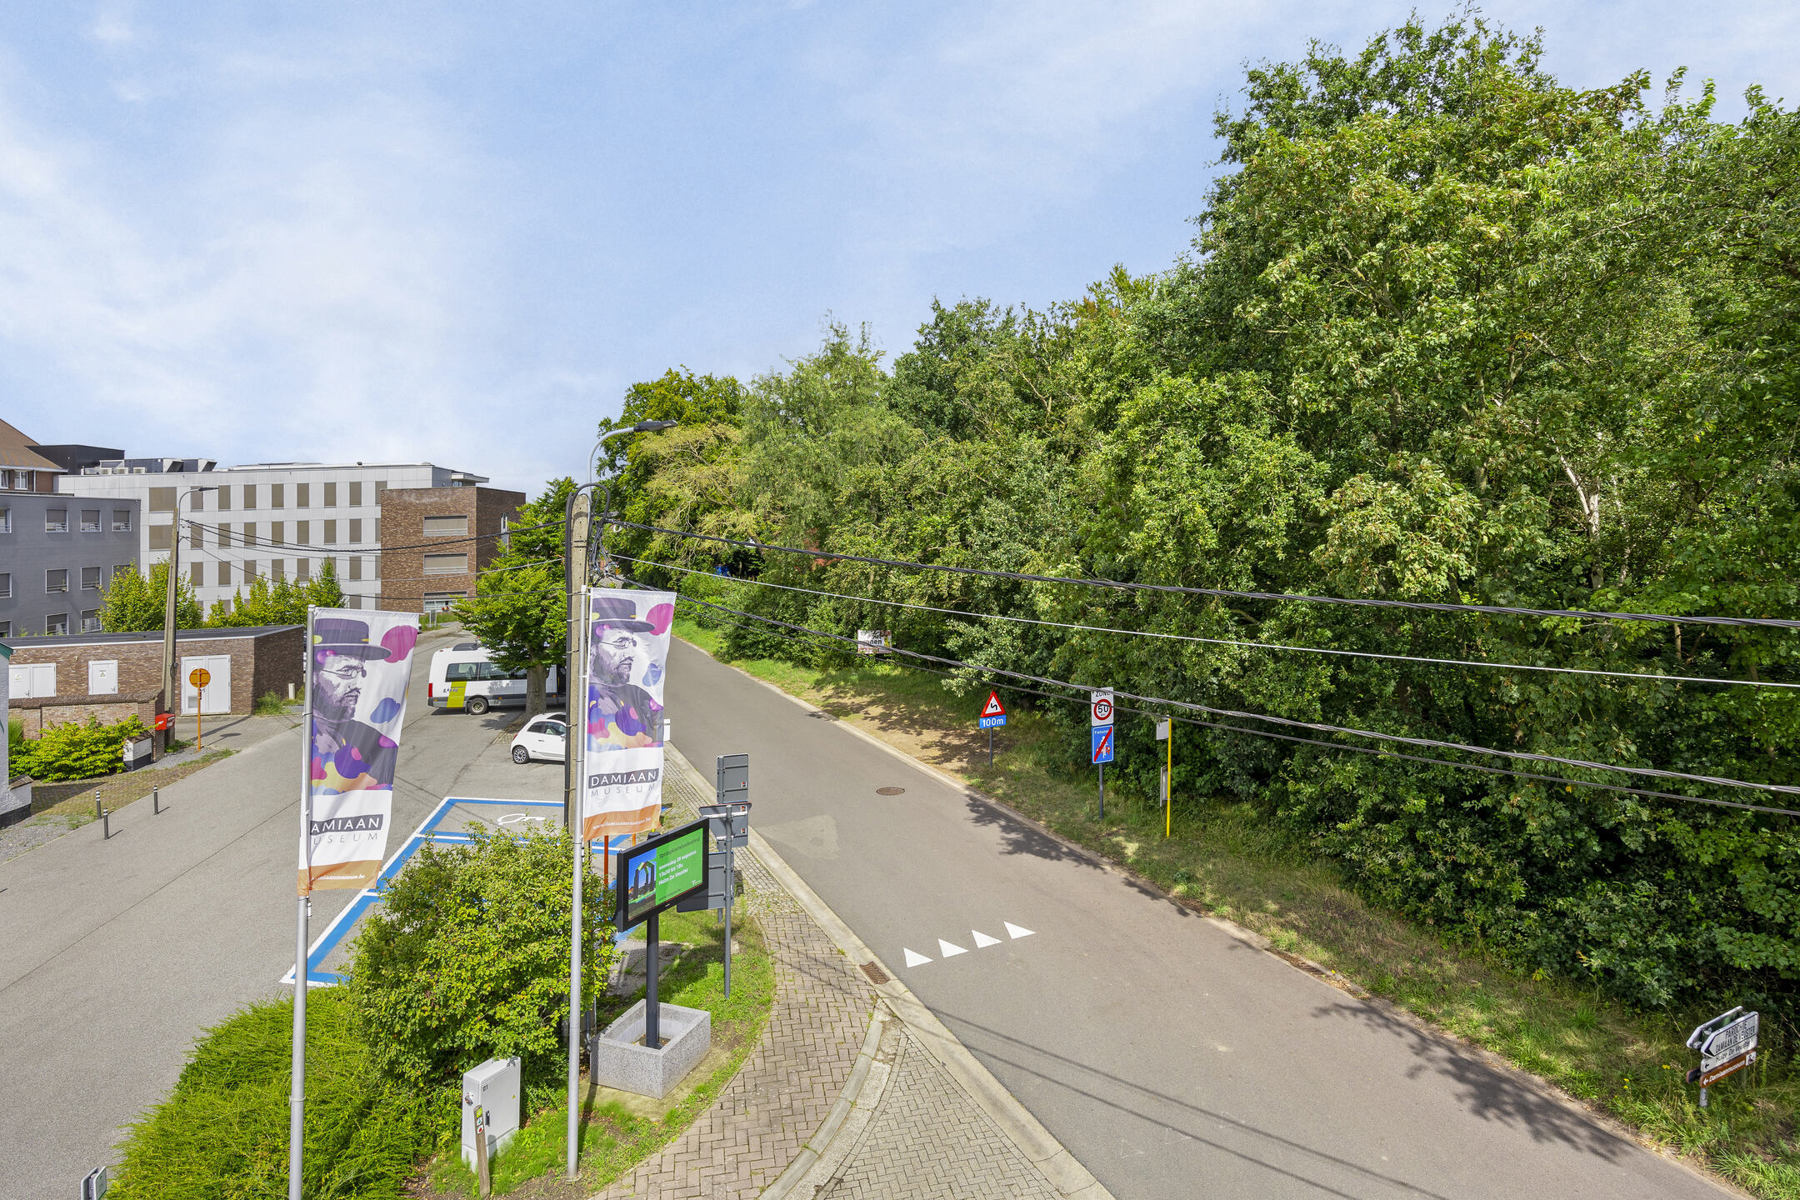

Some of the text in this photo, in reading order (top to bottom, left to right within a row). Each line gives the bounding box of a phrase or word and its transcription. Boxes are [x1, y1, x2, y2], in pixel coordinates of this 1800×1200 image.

[1097, 703, 1109, 714] 50
[983, 717, 1004, 727] 100m
[591, 771, 656, 786] DAMIAAN
[311, 817, 380, 833] AMIAAN
[313, 832, 378, 846] USEUM
